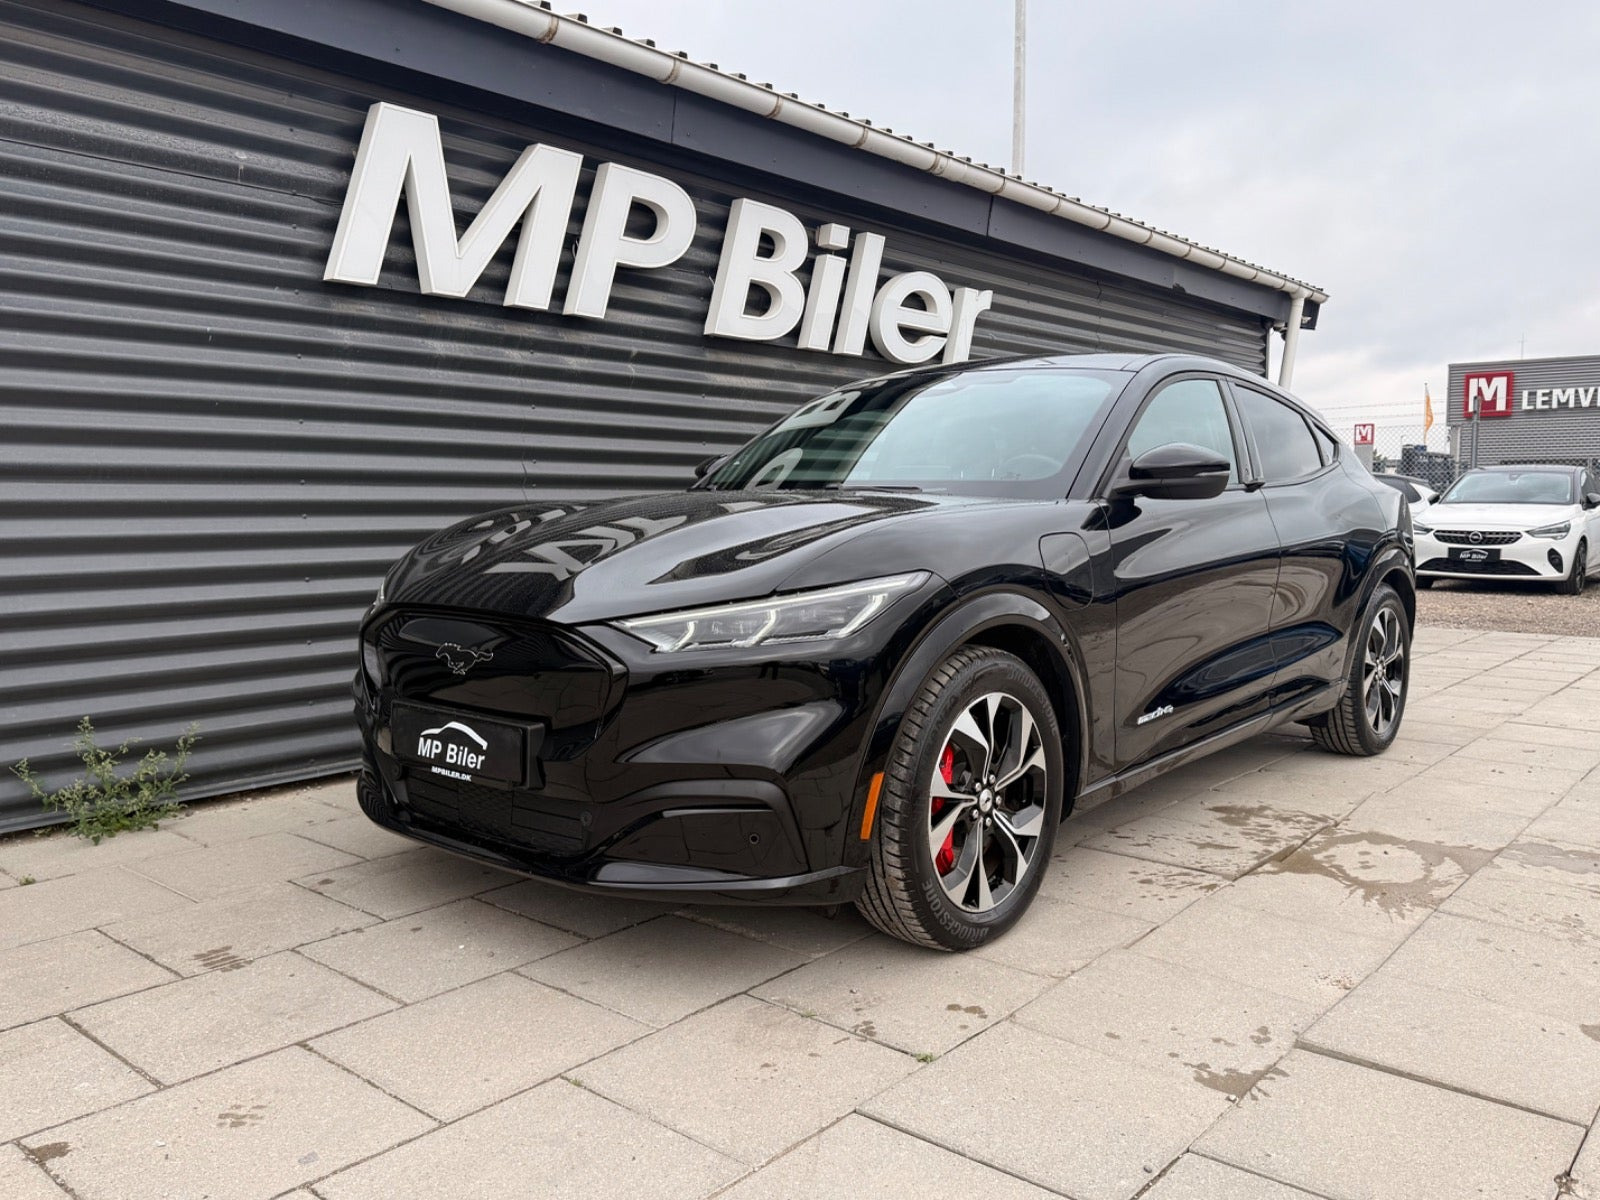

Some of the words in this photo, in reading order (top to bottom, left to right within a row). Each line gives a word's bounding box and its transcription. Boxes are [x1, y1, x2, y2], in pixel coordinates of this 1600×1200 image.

[323, 101, 698, 320] MP
[704, 197, 993, 364] Biler
[417, 736, 442, 759] MP
[446, 743, 486, 770] Biler
